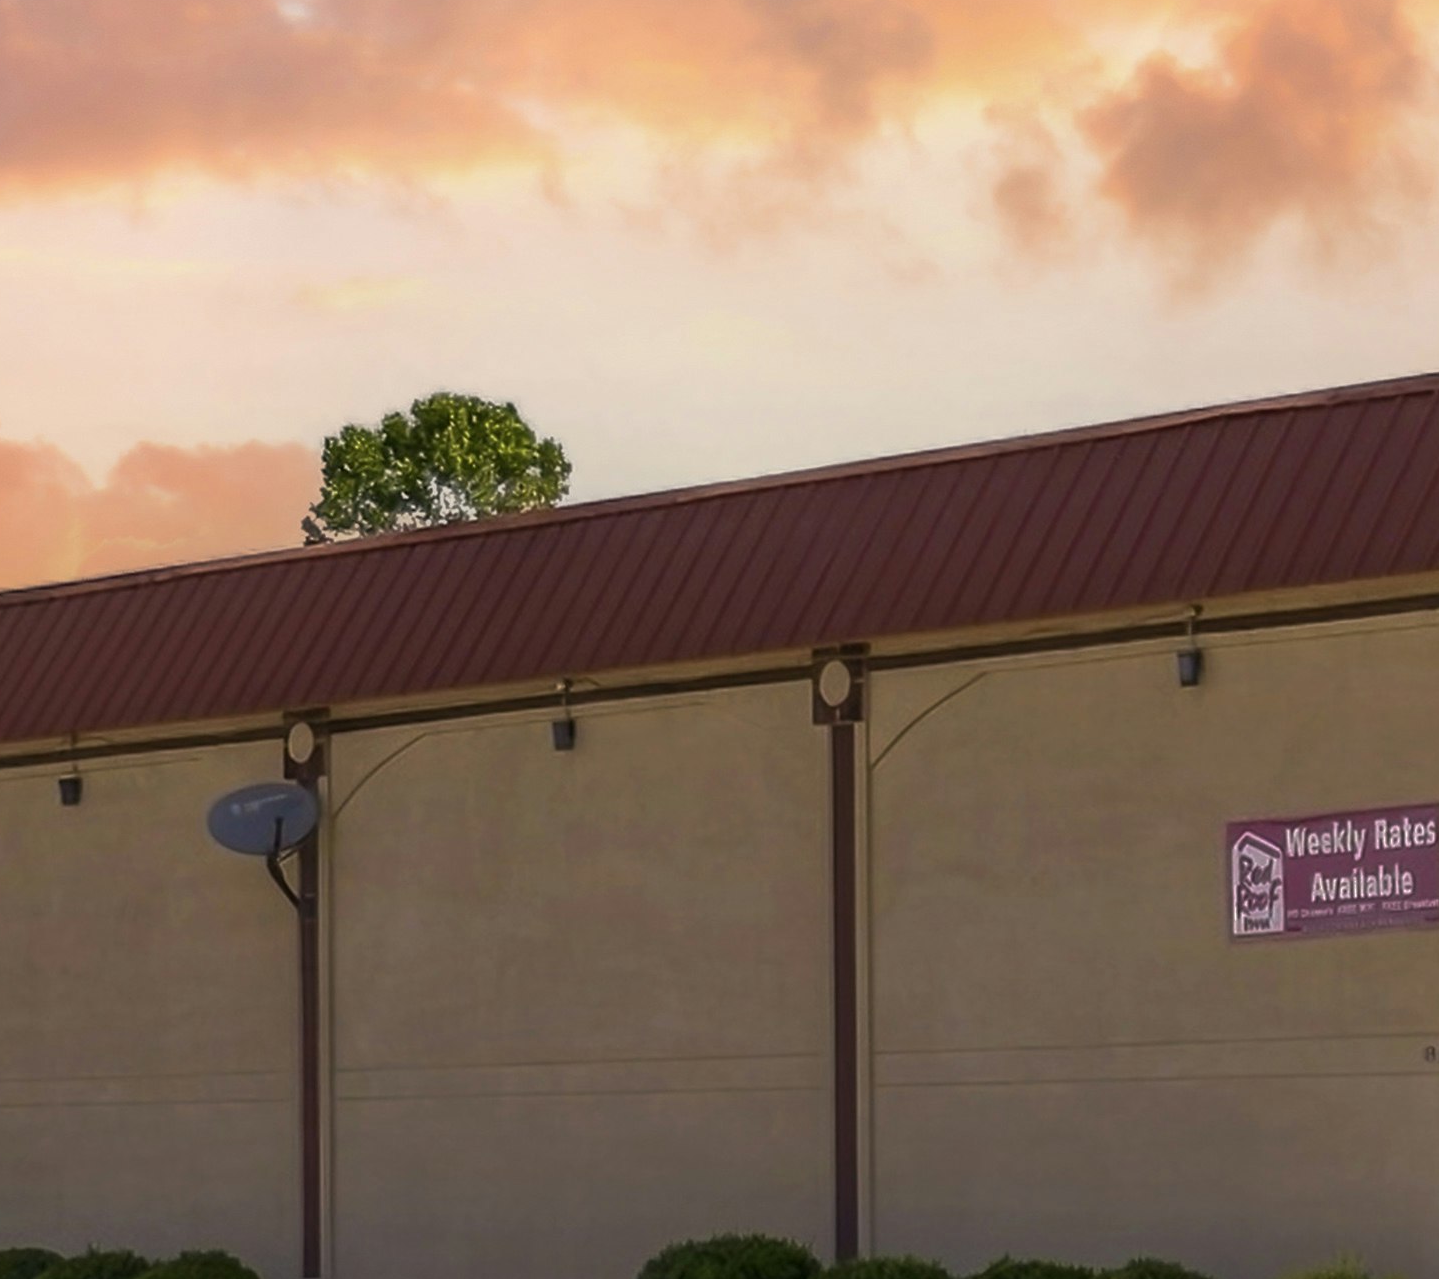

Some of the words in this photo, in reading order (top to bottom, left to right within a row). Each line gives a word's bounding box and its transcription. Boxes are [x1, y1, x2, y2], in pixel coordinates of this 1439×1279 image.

[1285, 819, 1367, 861] Weekly
[1374, 817, 1437, 851] Rates
[1237, 877, 1282, 920] Roof
[1311, 863, 1415, 903] Available
